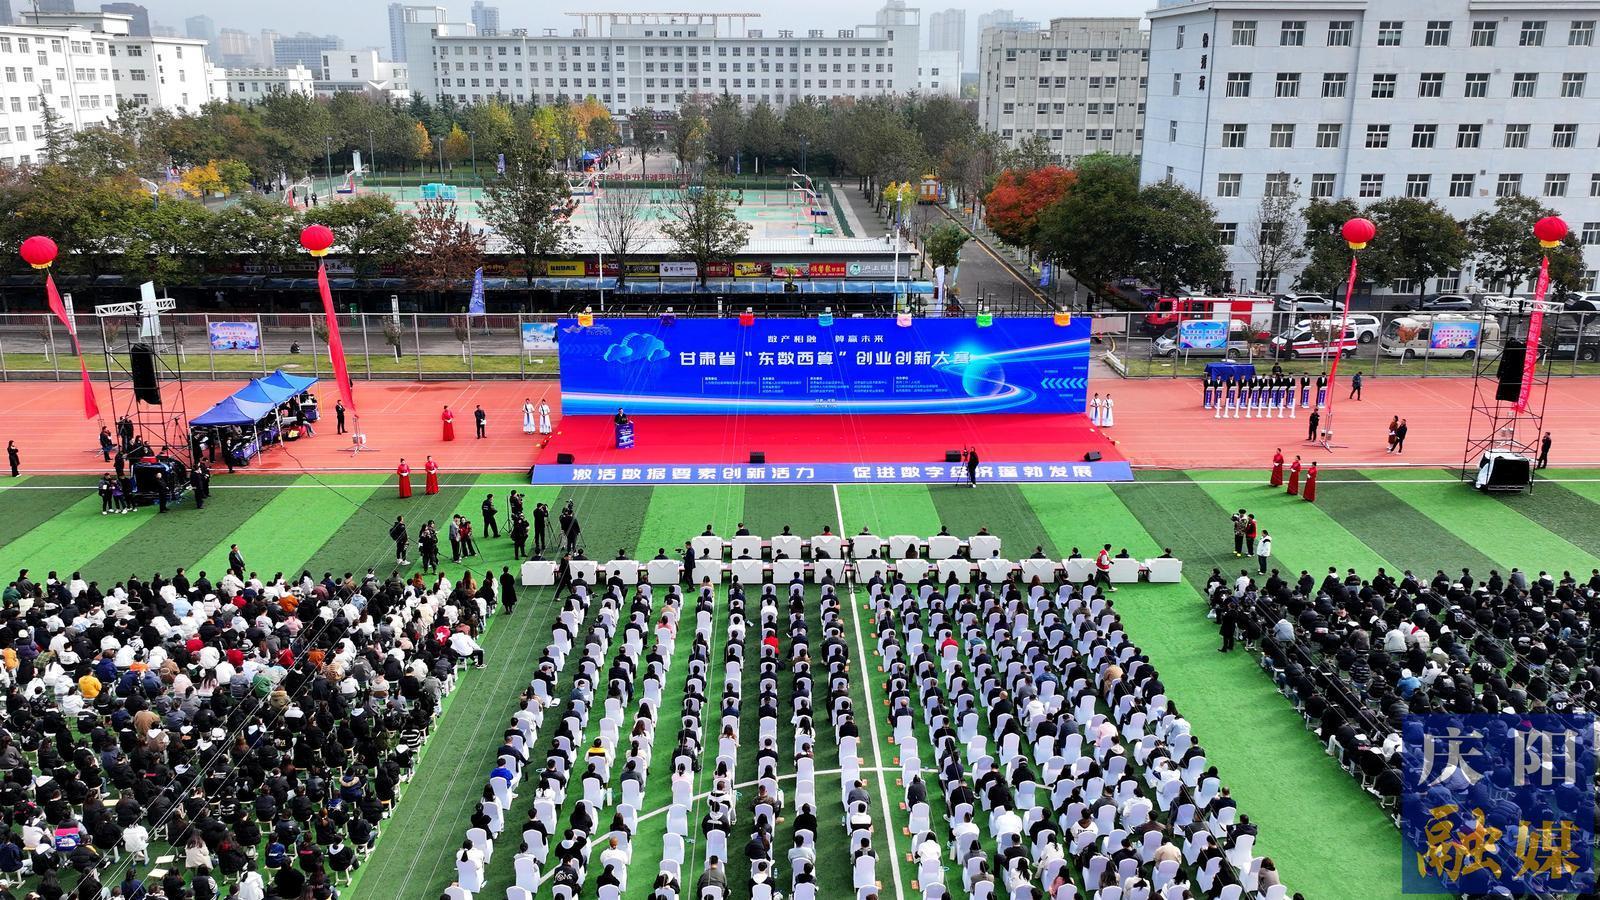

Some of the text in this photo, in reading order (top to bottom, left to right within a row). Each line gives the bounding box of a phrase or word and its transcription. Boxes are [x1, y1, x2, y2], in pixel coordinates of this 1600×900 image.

[767, 335, 884, 343] 数产相融 算赢未来
[572, 468, 815, 481] 激活数据要素创新活力
